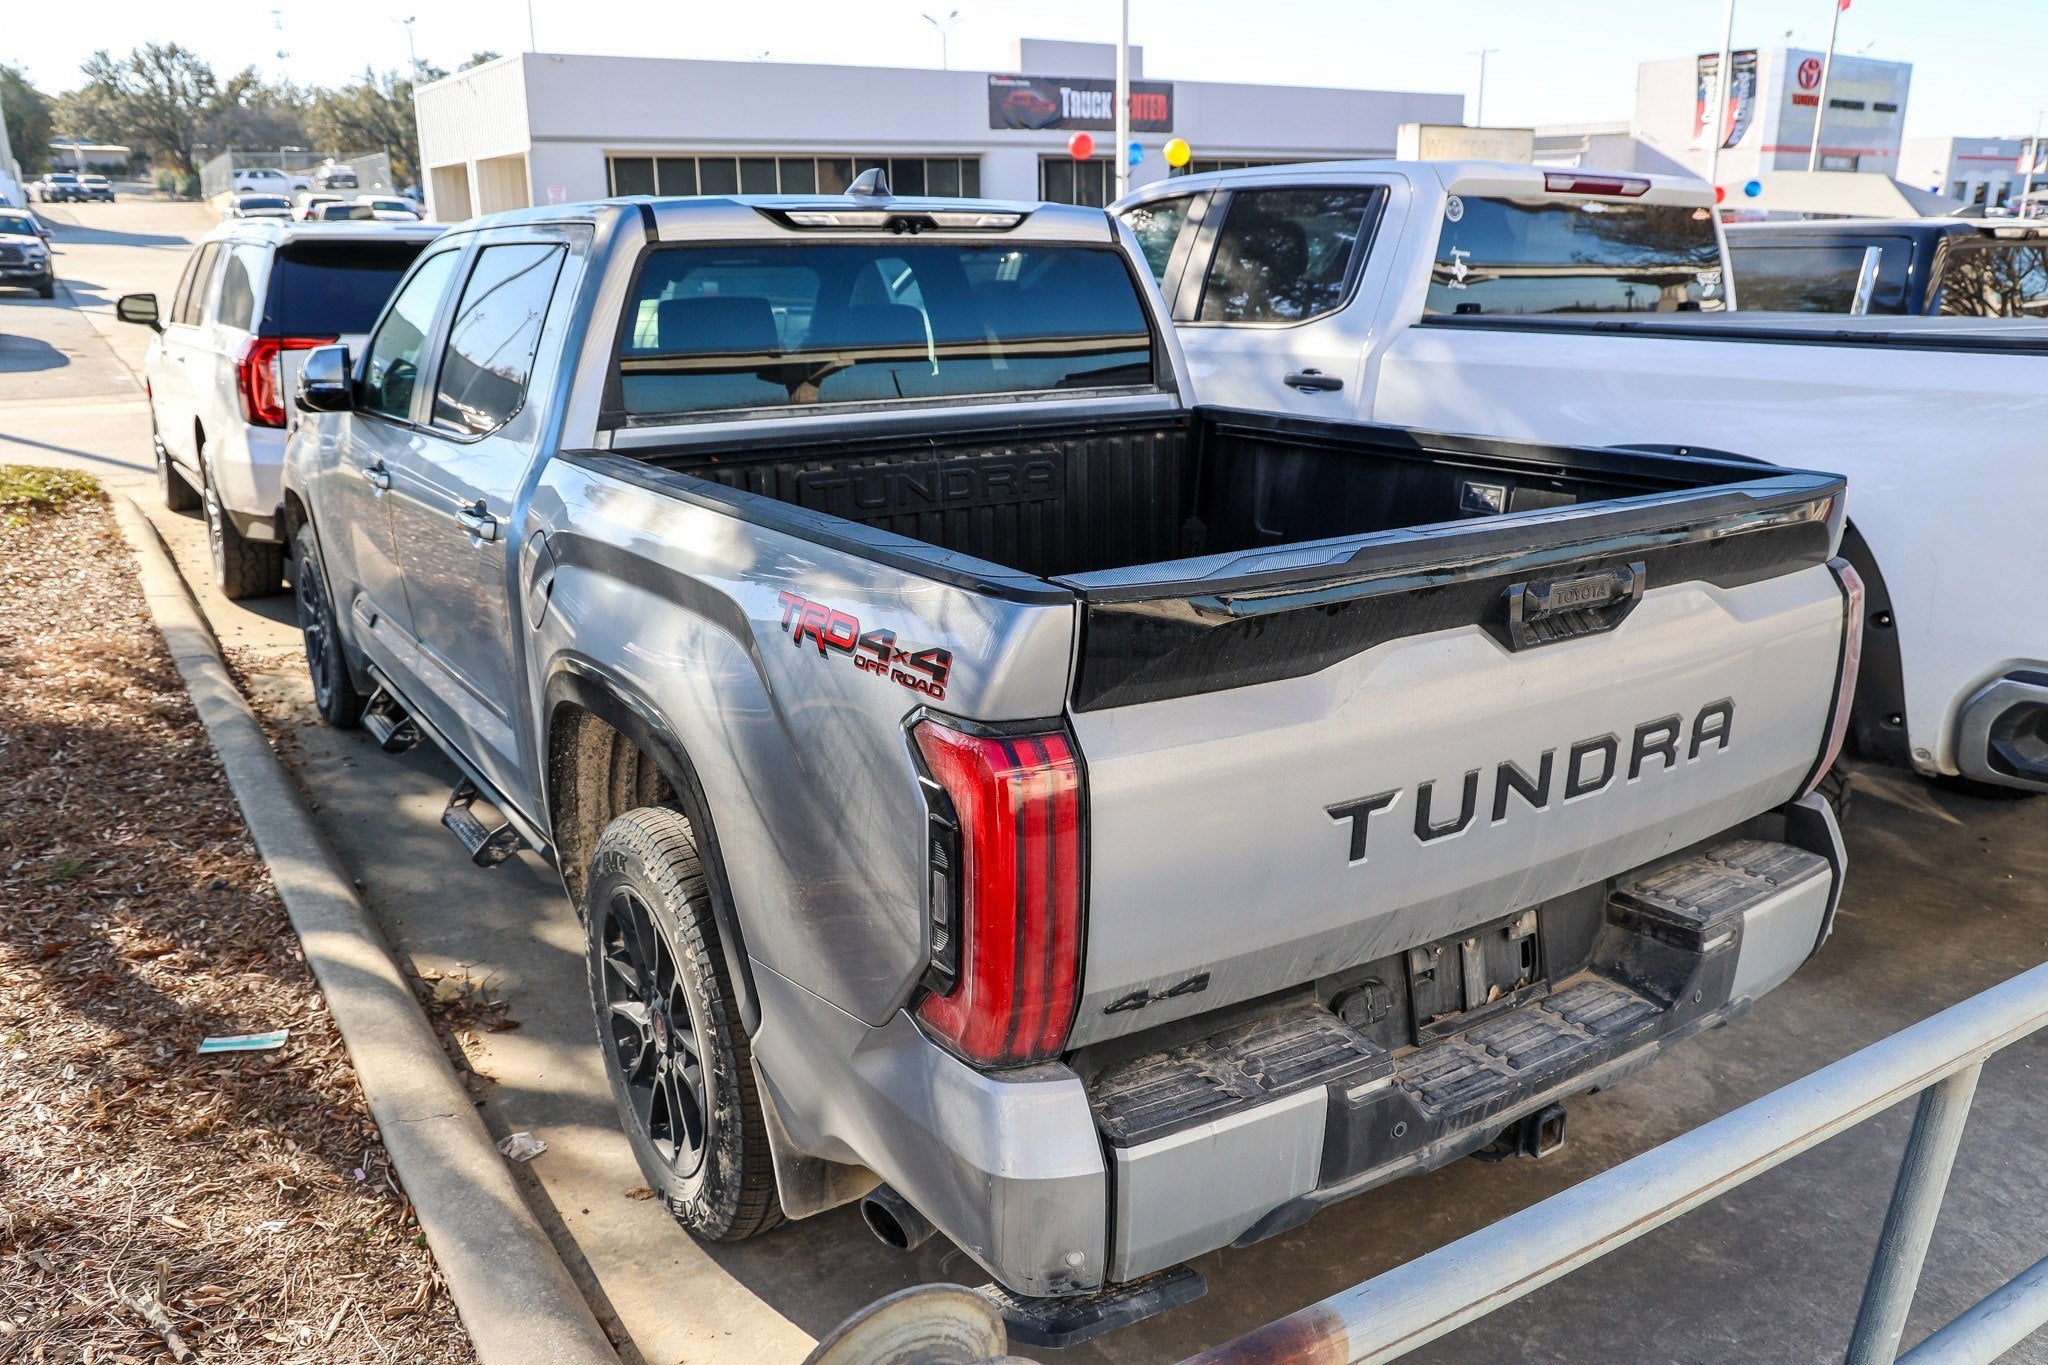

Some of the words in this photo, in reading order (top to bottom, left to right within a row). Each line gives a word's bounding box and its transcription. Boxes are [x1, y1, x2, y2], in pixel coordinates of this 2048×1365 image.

[1060, 87, 1112, 119] TRUCK
[809, 460, 1057, 513] TUNDRA
[1557, 582, 1606, 604] TOYOTA
[778, 590, 862, 660] TRD
[854, 654, 889, 676] OFF
[890, 668, 945, 701] ROAD
[1324, 696, 1736, 866] TUNDRA
